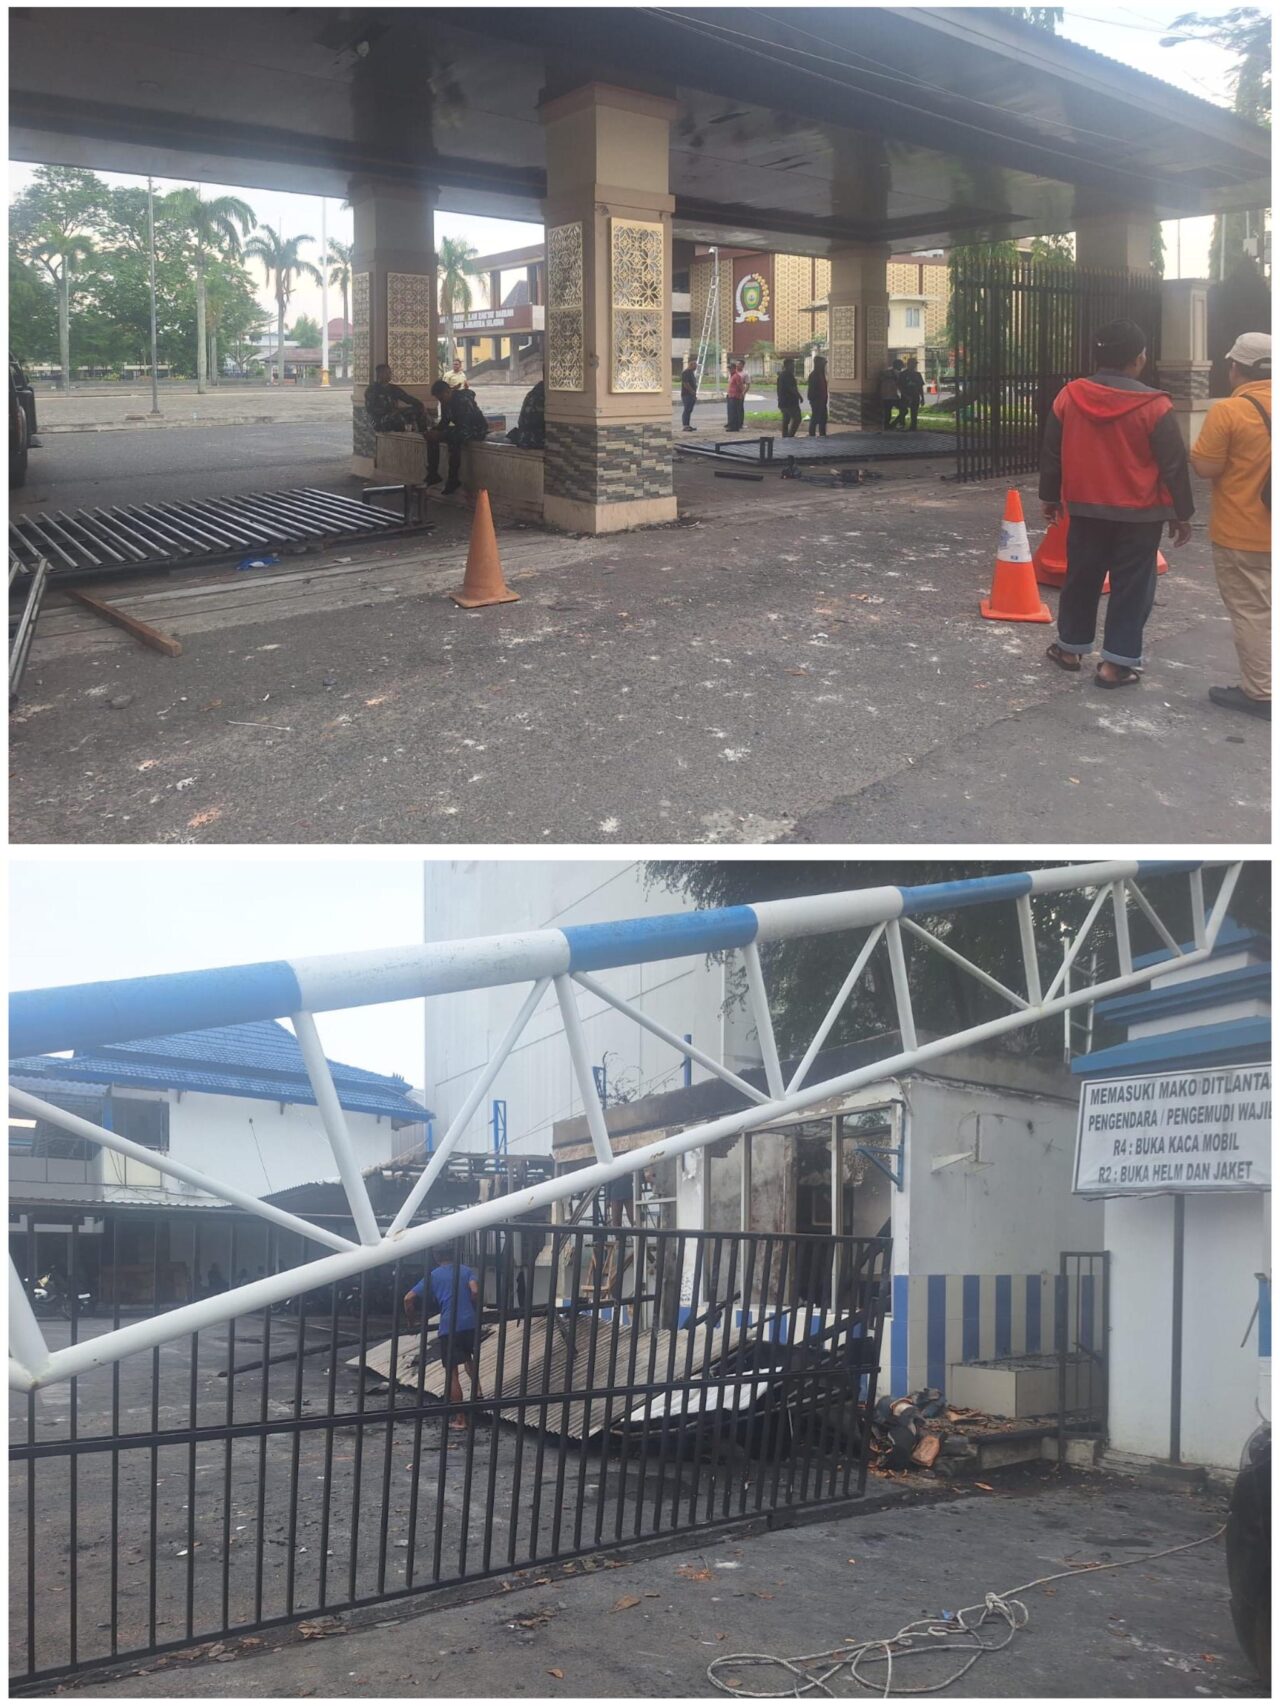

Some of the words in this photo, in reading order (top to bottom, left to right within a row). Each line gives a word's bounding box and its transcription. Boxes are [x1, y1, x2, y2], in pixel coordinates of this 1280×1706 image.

[1090, 1083, 1155, 1105] MEMASUKI
[1159, 1078, 1197, 1099] MAKO
[1201, 1071, 1271, 1096] DITLANTA
[1088, 1110, 1158, 1131] PENGENDARA
[1167, 1103, 1234, 1126] PENGEMUDI
[1113, 1139, 1126, 1156] R4
[1135, 1136, 1165, 1155] BUKA
[1169, 1134, 1199, 1153] KACA
[1202, 1132, 1240, 1151] MOBIL
[1099, 1166, 1112, 1183] R2
[1120, 1165, 1149, 1182] BUKA
[1152, 1163, 1184, 1181] HELM
[1187, 1162, 1210, 1181] DAN
[1213, 1161, 1253, 1180] JAKET
